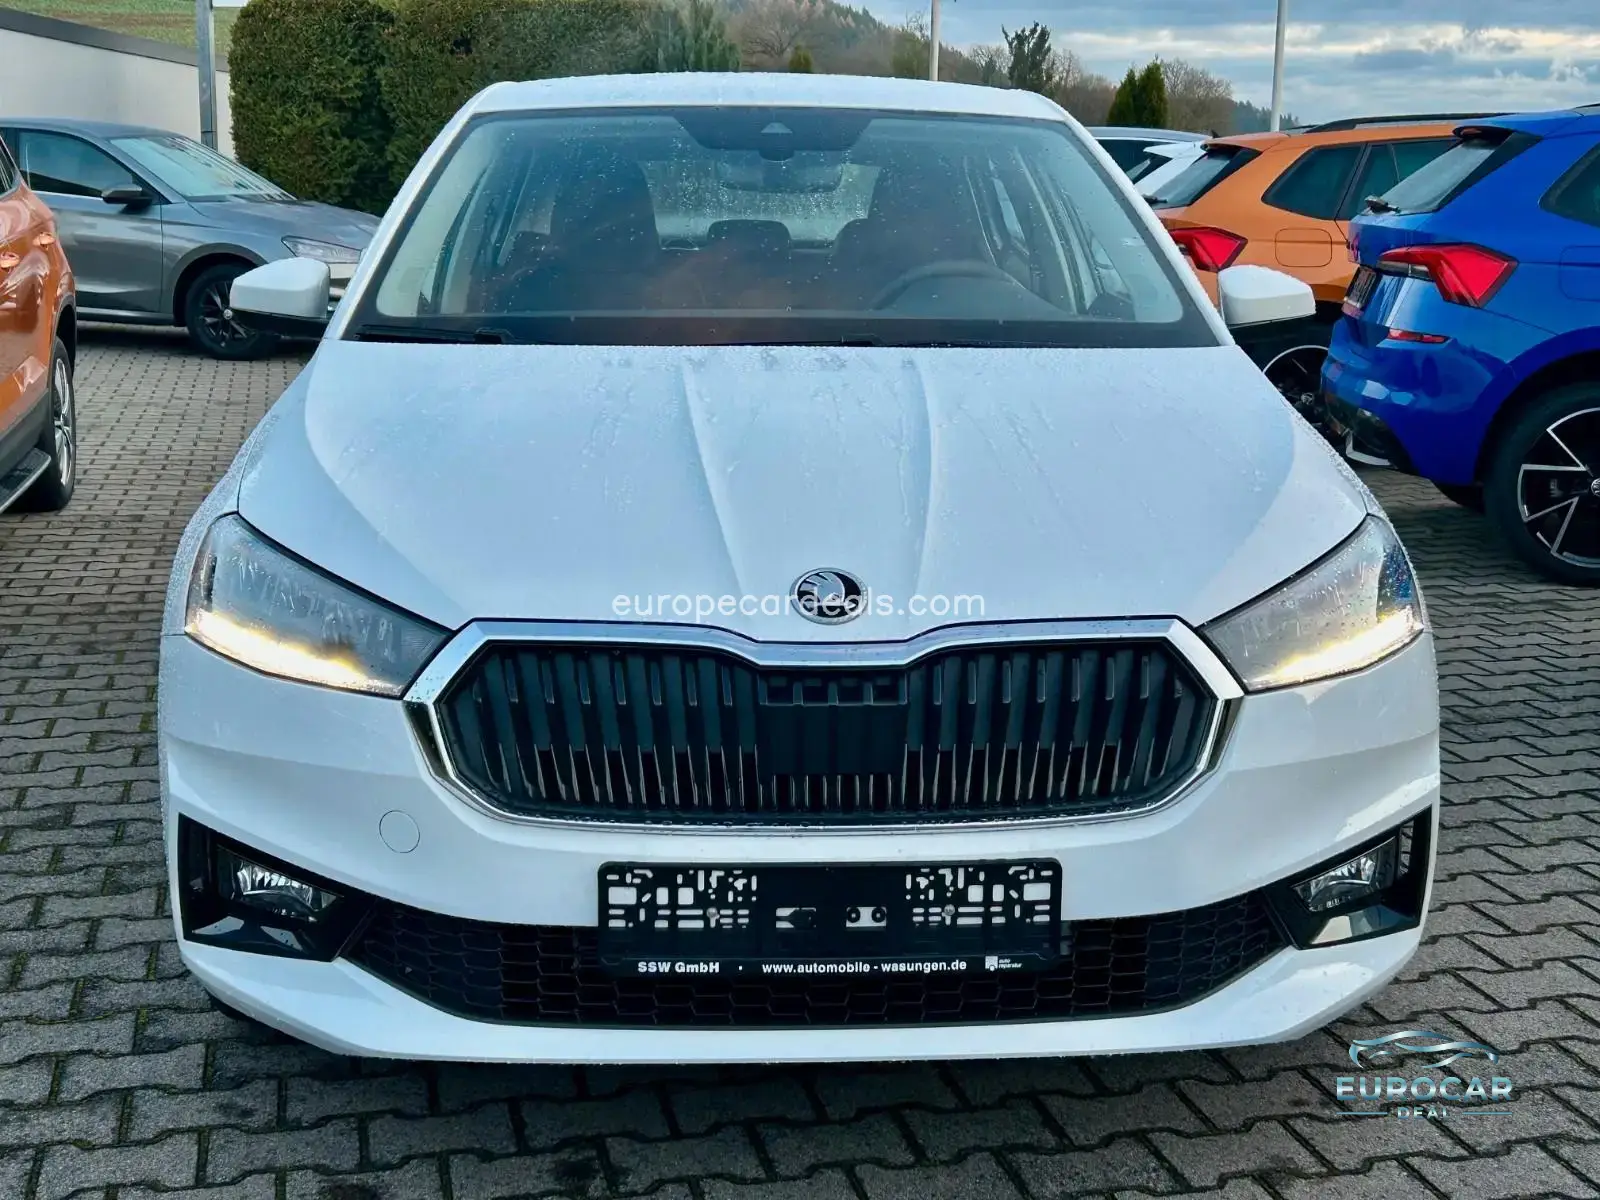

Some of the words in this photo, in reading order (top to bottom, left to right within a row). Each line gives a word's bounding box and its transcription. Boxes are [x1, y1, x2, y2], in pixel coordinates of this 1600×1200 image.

[637, 961, 671, 974] SSW
[674, 961, 720, 974] GmbH
[762, 961, 871, 974] www.automobile
[881, 959, 967, 974] wasungen.de
